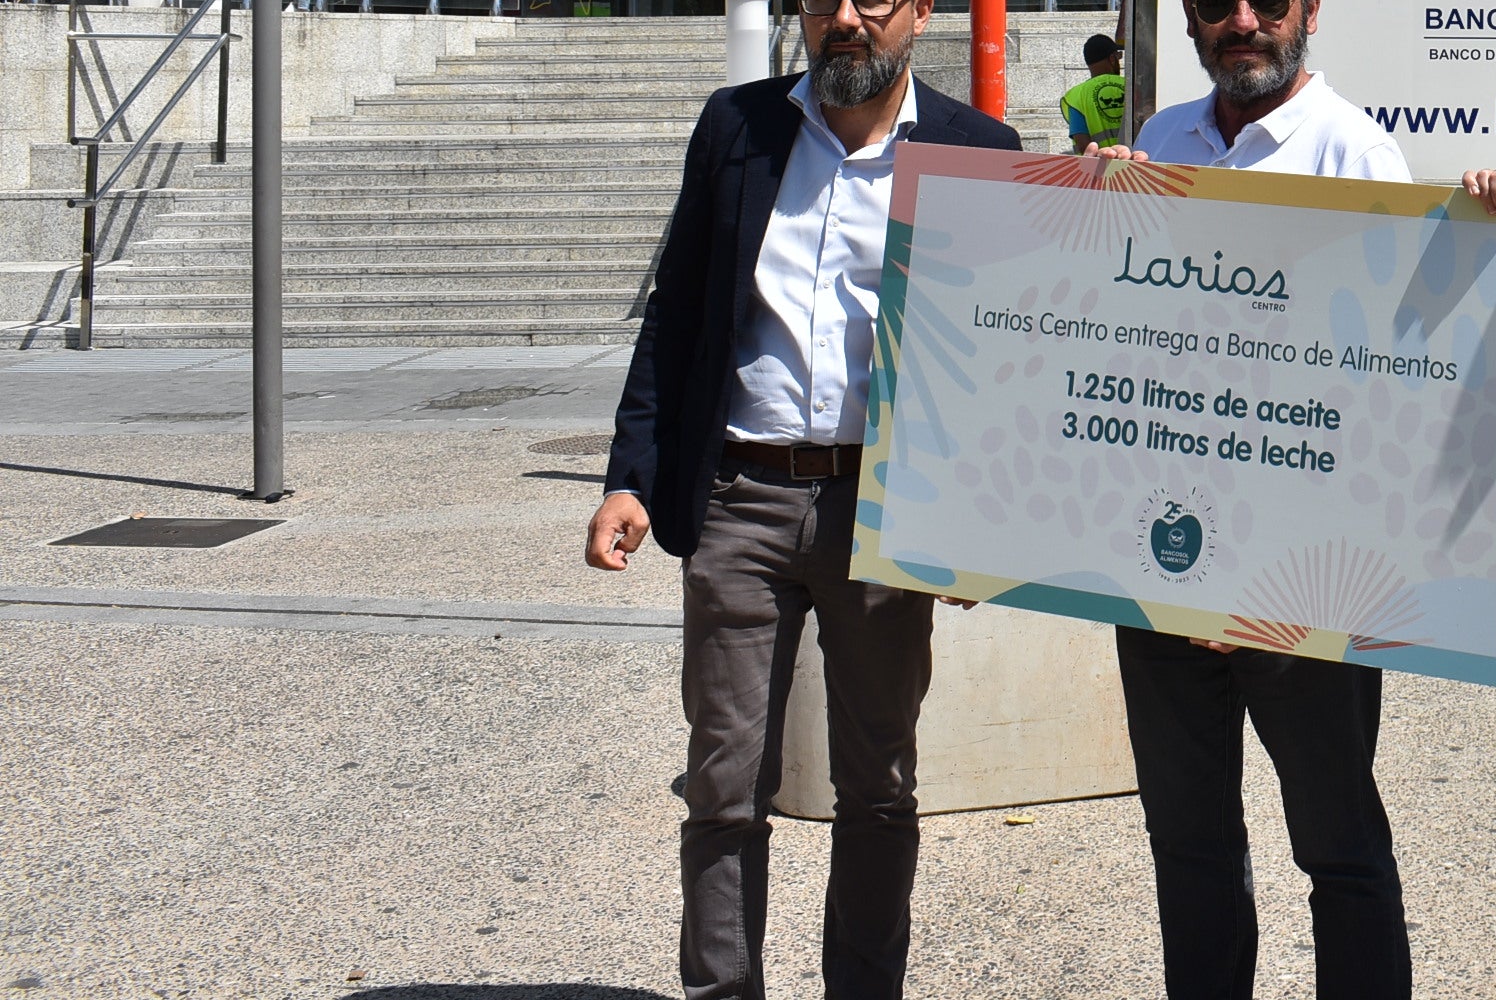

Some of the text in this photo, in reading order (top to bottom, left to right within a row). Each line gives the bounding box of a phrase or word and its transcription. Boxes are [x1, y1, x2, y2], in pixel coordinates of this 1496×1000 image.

[1429, 48, 1481, 61] BANCO
[1114, 237, 1289, 300] Larios
[1251, 301, 1286, 312] CENTRO
[974, 304, 1458, 381] Larios Centro entrega a Banco de Alimentos
[1066, 370, 1341, 430] 1.250 litros de aceite
[1062, 411, 1336, 473] 3.000 litros de leche
[1163, 500, 1182, 520] 25
[1160, 556, 1189, 565] ALIMENTOS
[1161, 549, 1189, 559] BANCOSOL
